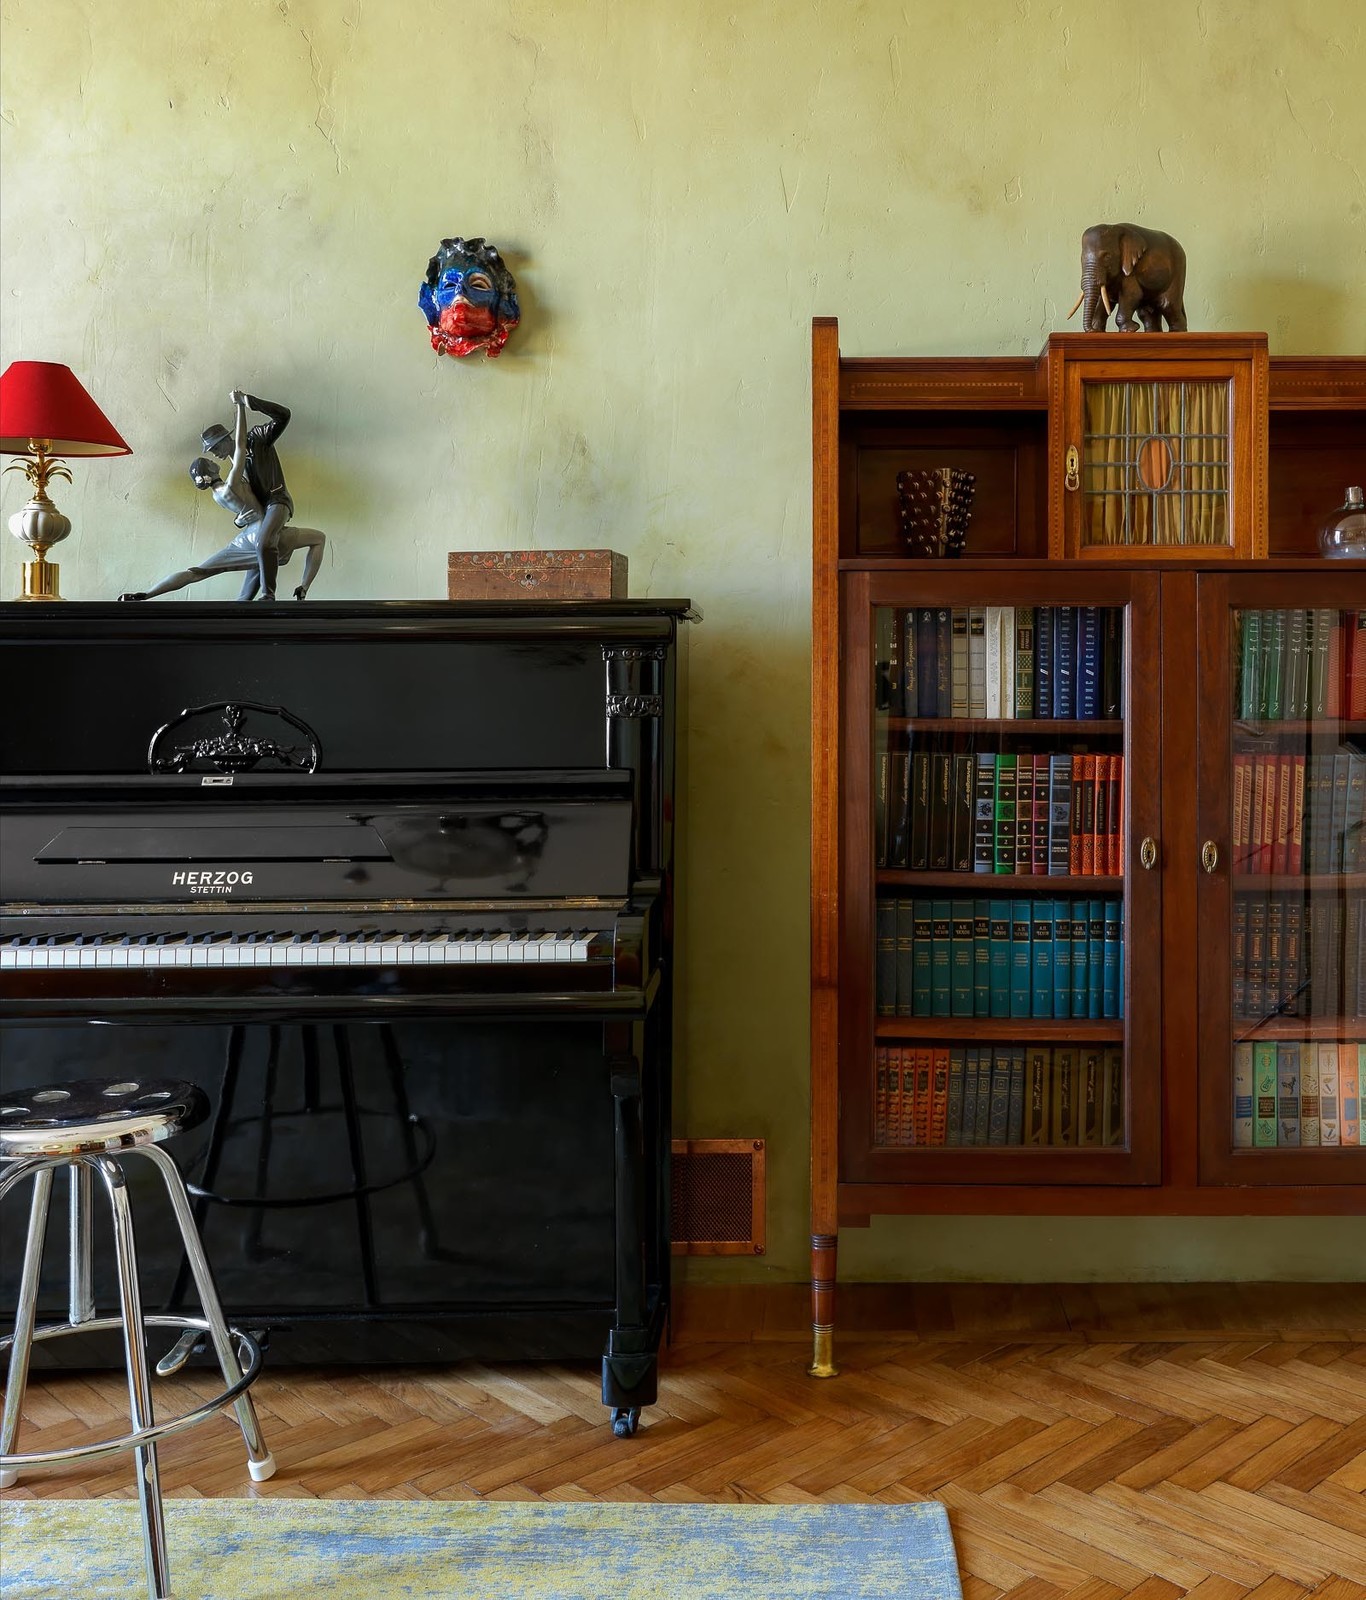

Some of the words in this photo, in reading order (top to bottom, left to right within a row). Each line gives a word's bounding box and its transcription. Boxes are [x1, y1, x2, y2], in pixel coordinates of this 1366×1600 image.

[1261, 703, 1266, 711] 2
[1318, 704, 1322, 712] 6
[172, 871, 253, 885] HERZOG
